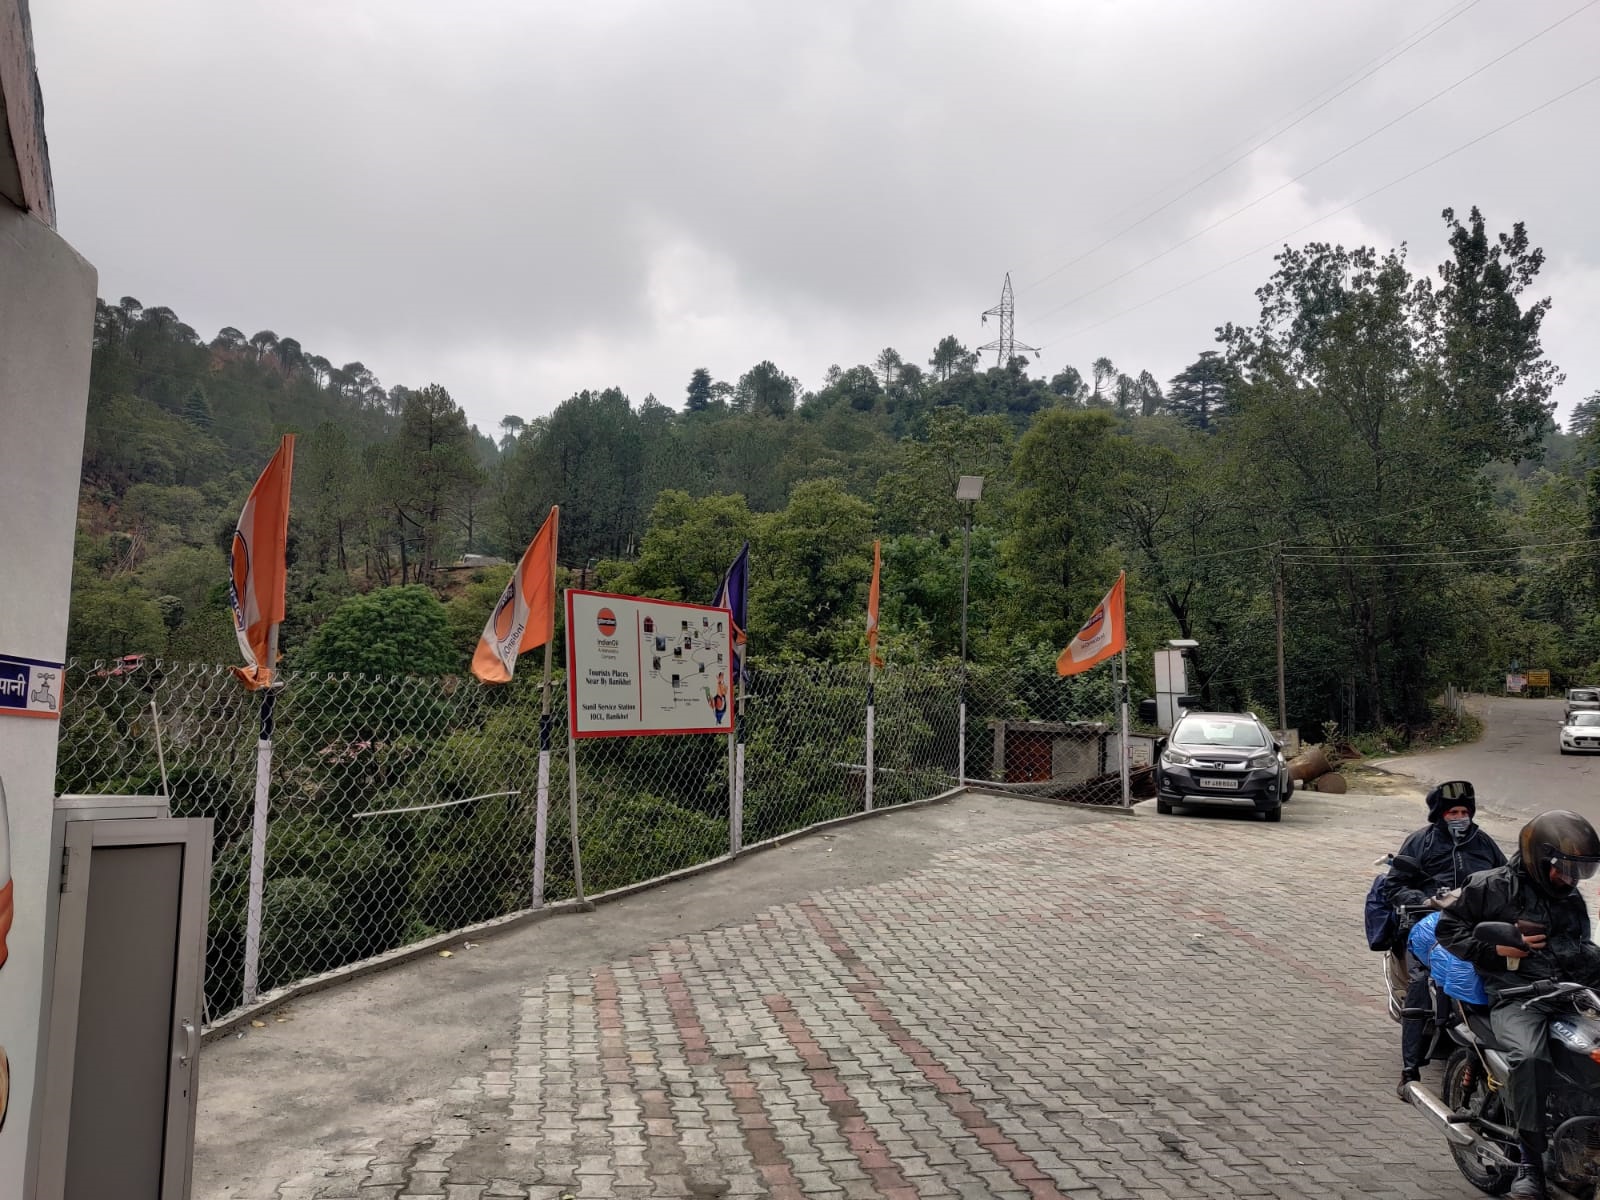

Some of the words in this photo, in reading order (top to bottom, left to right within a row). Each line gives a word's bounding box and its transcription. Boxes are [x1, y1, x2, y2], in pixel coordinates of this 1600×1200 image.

[589, 668, 610, 677] Tourists
[612, 669, 628, 677] Places
[600, 678, 607, 687] By
